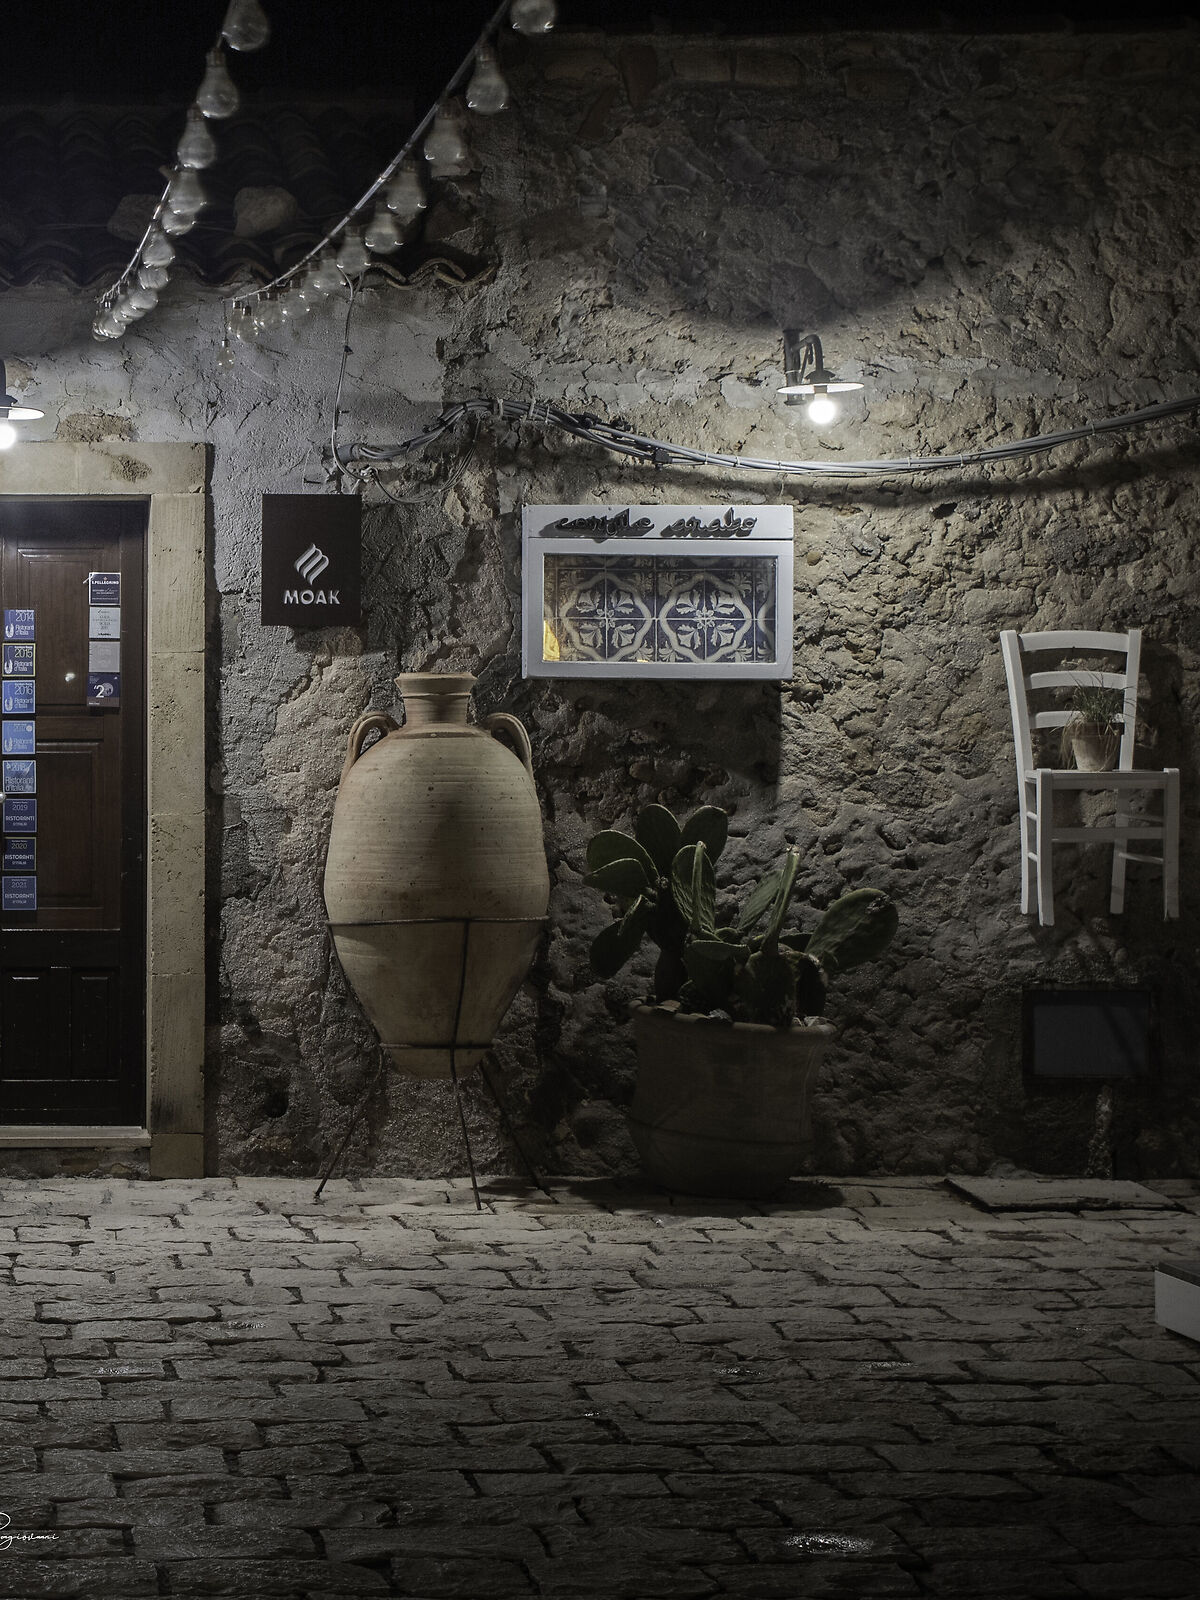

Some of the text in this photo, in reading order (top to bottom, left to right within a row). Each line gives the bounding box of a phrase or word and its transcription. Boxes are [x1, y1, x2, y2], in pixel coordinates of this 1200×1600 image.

[283, 589, 341, 605] MOAK
[15, 612, 35, 622] 2014
[14, 648, 33, 658] 2015
[14, 685, 33, 695] 2016
[11, 842, 28, 850] 2020
[11, 881, 28, 889] 2021
